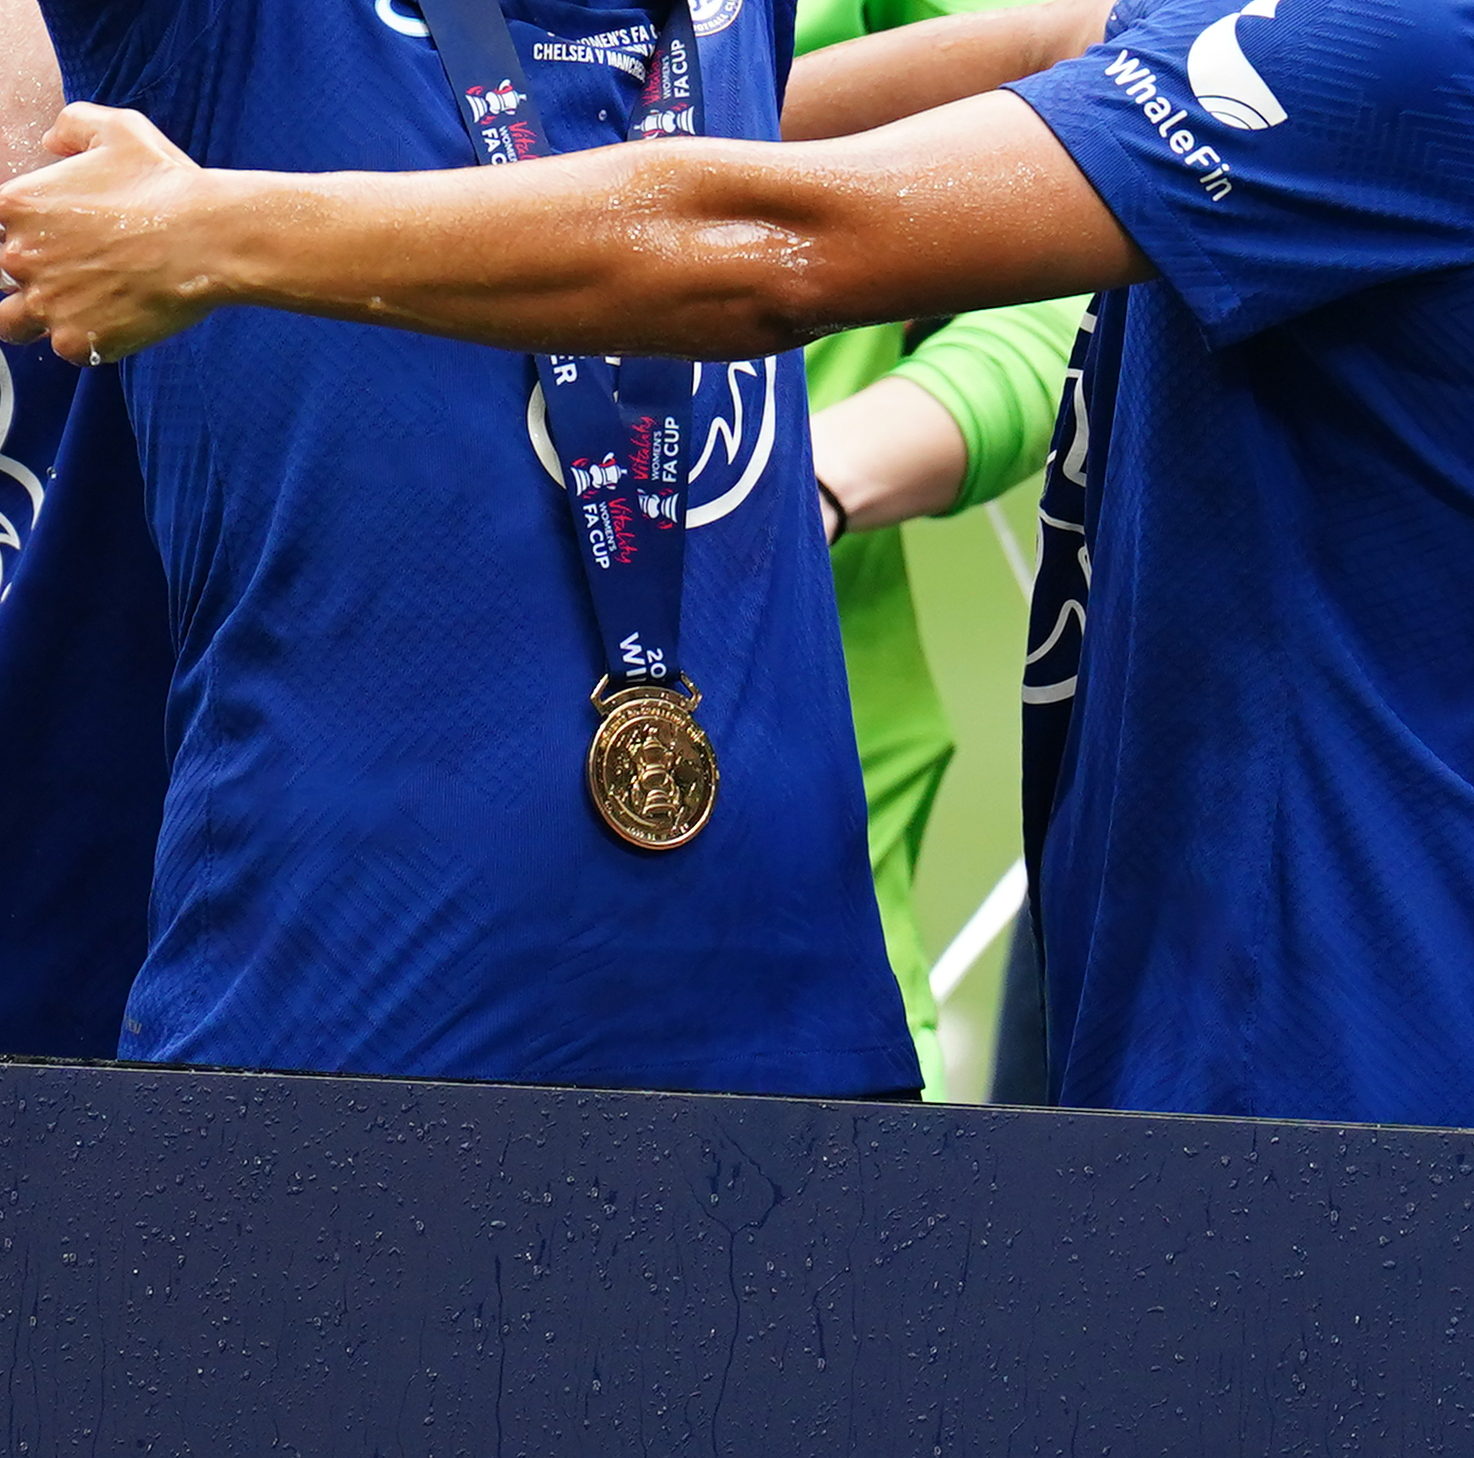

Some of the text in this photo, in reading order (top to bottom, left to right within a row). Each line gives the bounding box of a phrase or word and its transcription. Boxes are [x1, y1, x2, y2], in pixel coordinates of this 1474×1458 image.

[533, 42, 595, 64] CHELSEA
[594, 47, 604, 65] V
[630, 24, 650, 43] FA
[670, 38, 691, 99] FA CUP
[481, 127, 502, 153] FA
[508, 120, 540, 161] Vital
[1104, 49, 1233, 202] WhaleFin
[628, 415, 660, 481] Vitality
[651, 430, 663, 481] WOMEN'S
[661, 416, 680, 483] FA CUP
[582, 502, 611, 570] FA CUP
[598, 500, 618, 553] WOMEN'S
[608, 497, 639, 565] Vitality
